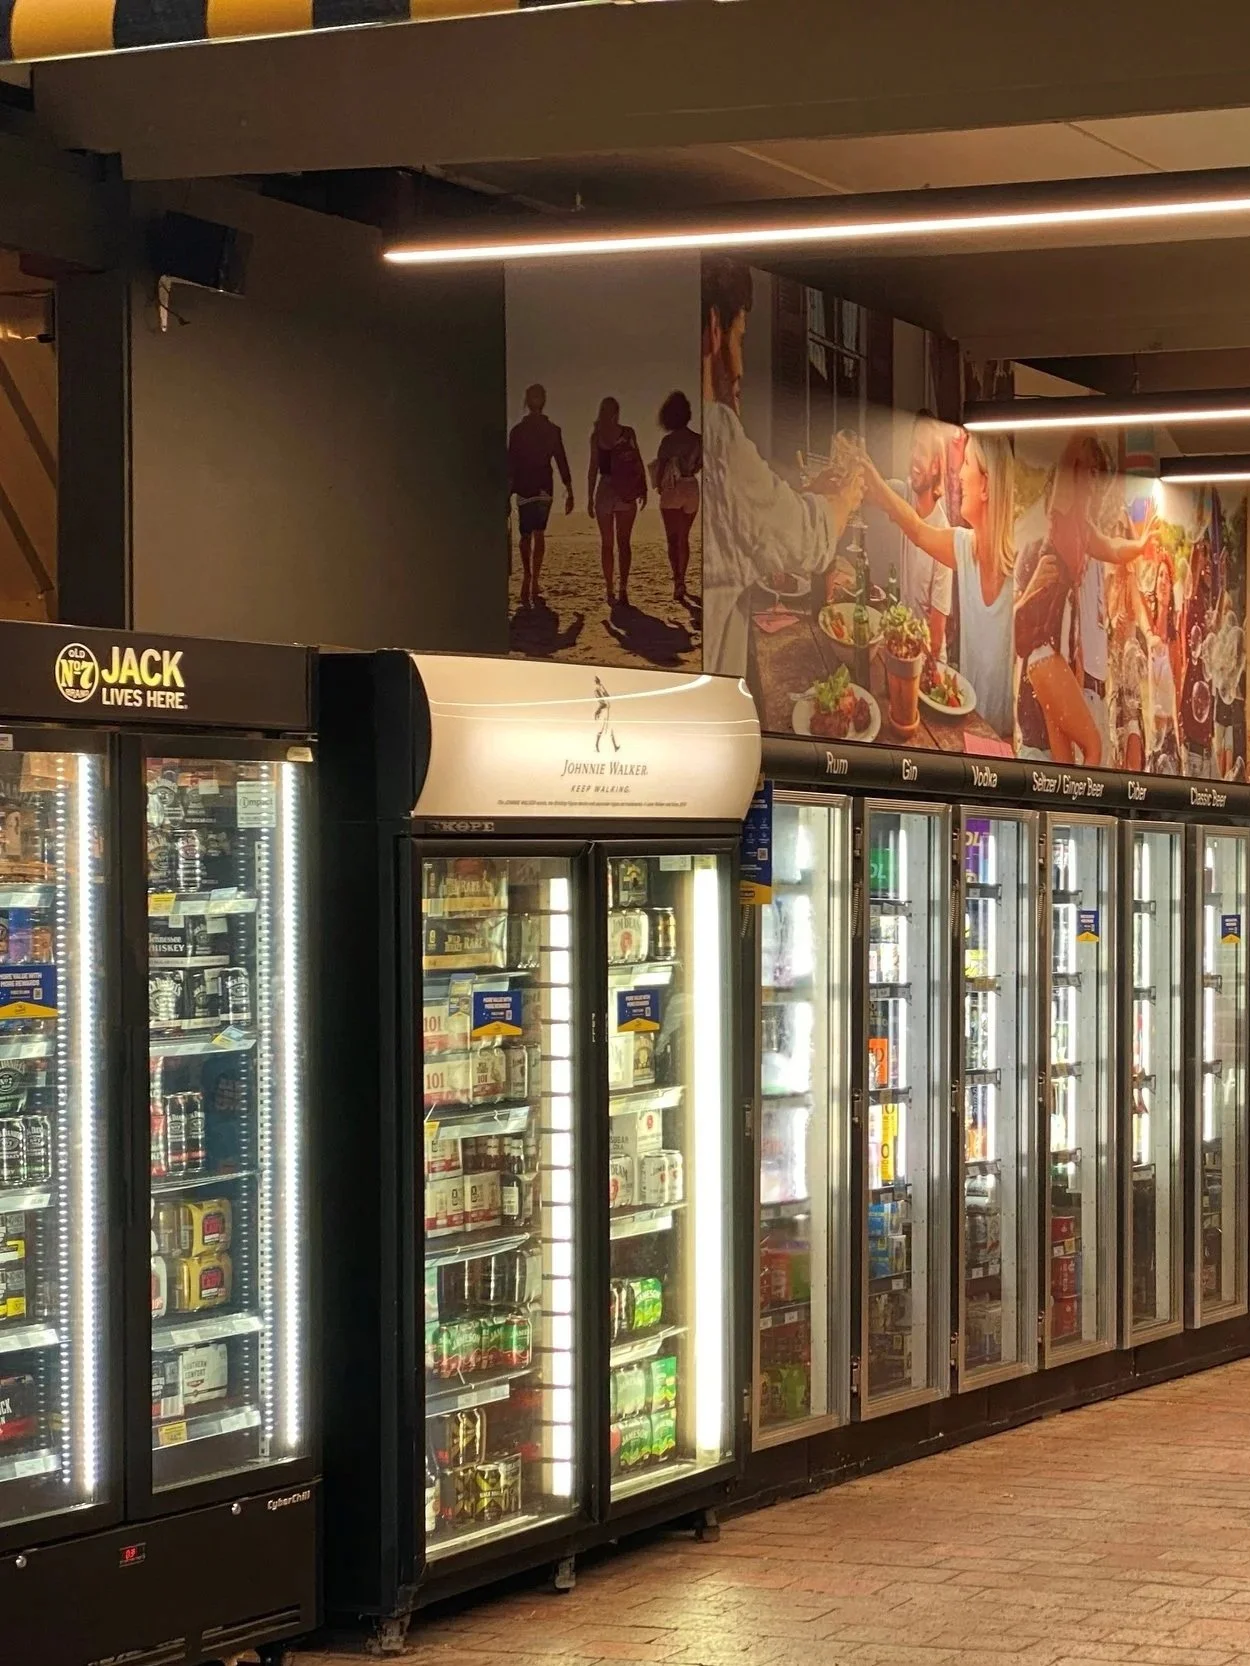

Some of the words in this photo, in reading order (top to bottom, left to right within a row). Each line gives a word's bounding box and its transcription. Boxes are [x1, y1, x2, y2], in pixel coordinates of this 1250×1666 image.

[68, 648, 86, 659] OLD
[101, 646, 185, 688] JACK
[102, 687, 143, 707] LIVES
[560, 759, 606, 777] JOHNNIE
[825, 751, 849, 774] Rum
[902, 758, 918, 781] Gin
[971, 766, 998, 787] Vodka
[1032, 771, 1057, 792] Seltzer
[1063, 775, 1087, 800] Ginger
[1087, 780, 1105, 797] Beer
[571, 784, 591, 793] KEEP
[1127, 781, 1148, 800] Cider
[1190, 787, 1211, 806] Classic
[1212, 790, 1227, 808] Beer
[424, 1016, 441, 1032] 101
[426, 1073, 445, 1090] 101
[267, 1490, 311, 1511] CyberChill
